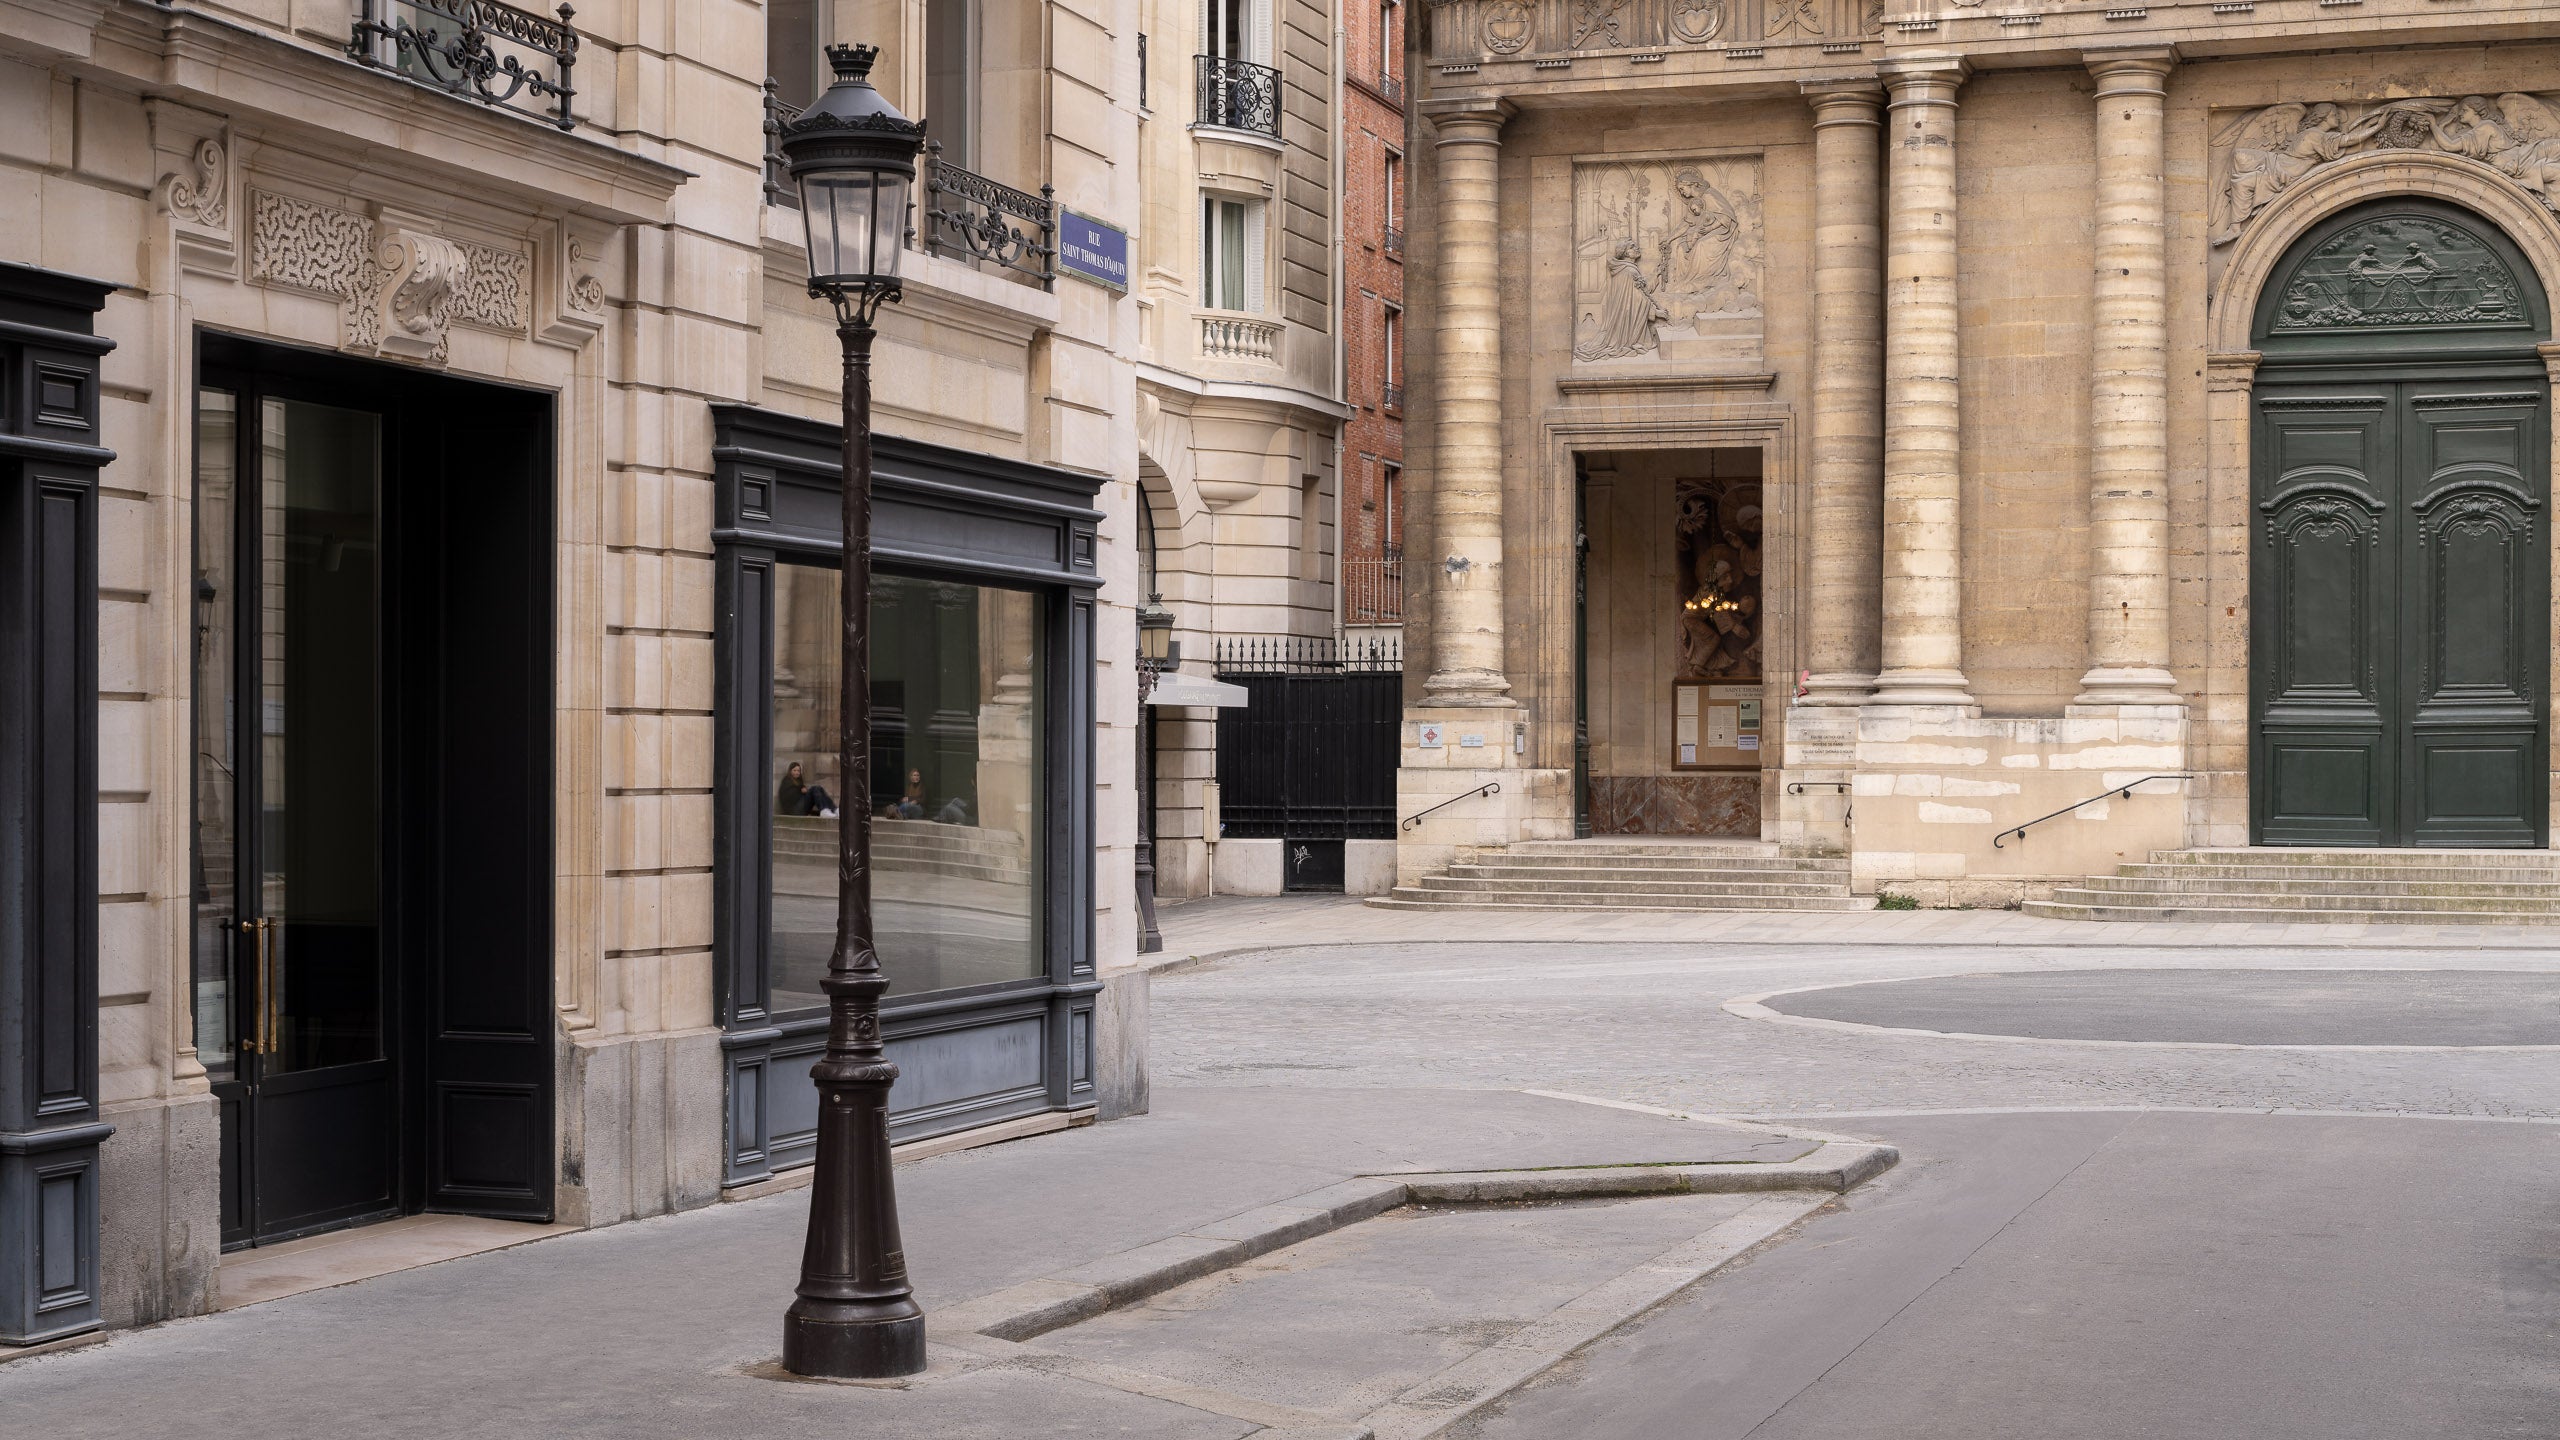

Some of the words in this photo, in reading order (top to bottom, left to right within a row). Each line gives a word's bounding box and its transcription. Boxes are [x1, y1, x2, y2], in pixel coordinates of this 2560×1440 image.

[1088, 230, 1101, 247] RUE
[1062, 241, 1080, 260] SAINT
[1080, 248, 1104, 269] THOMAS
[1104, 255, 1126, 276] D'AQUIN
